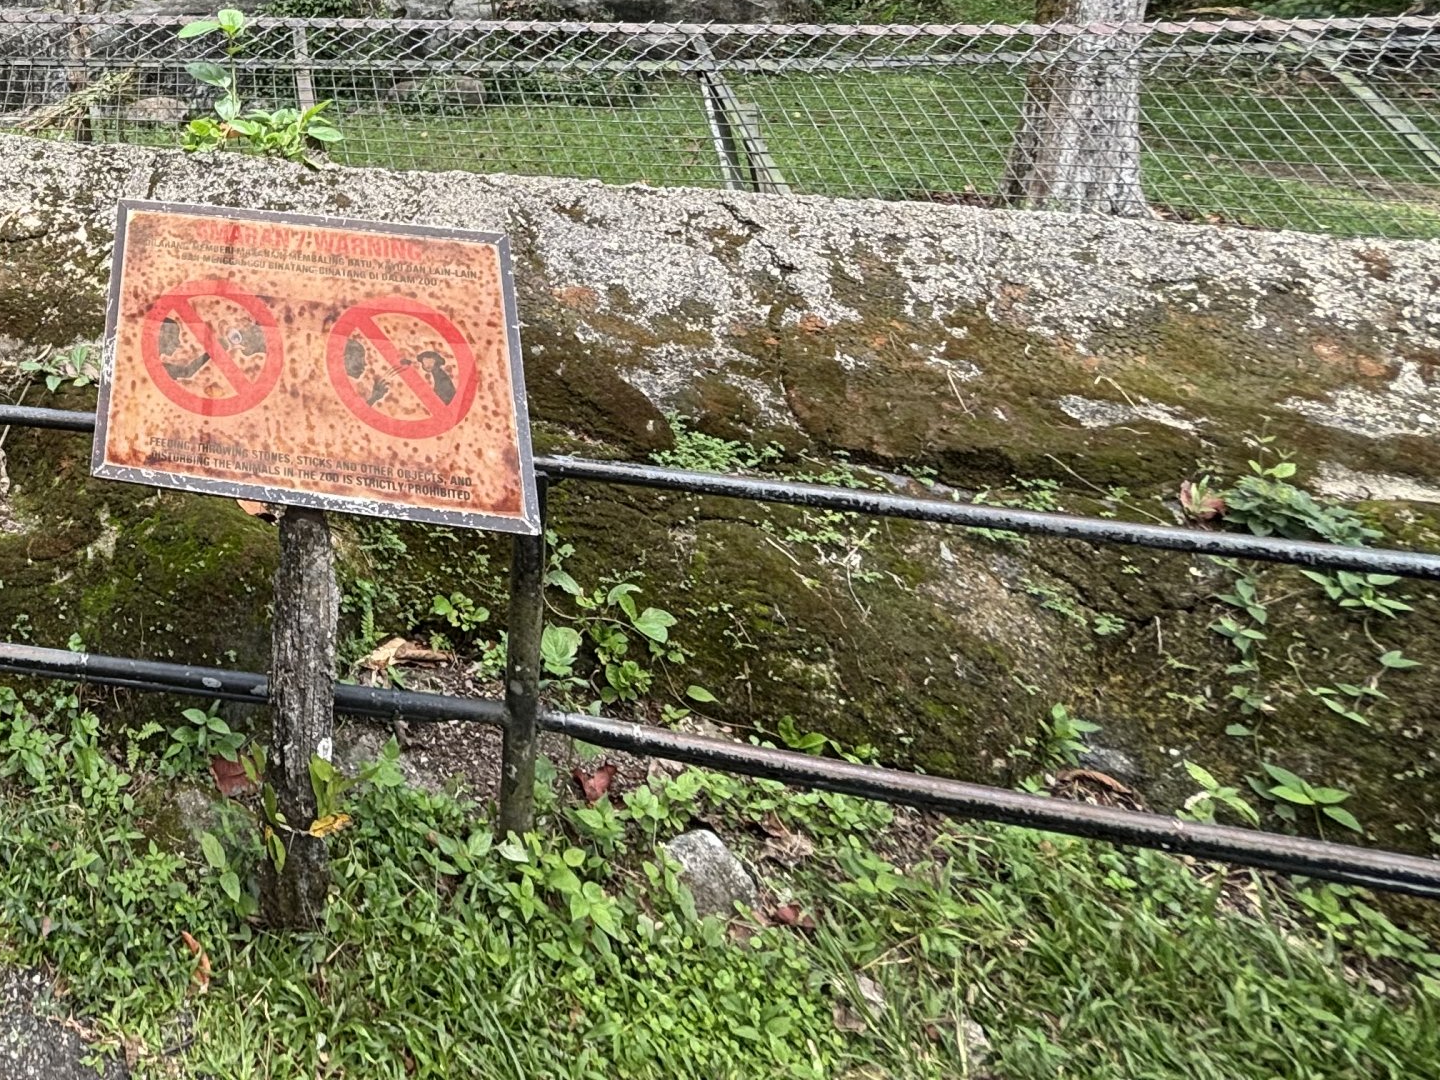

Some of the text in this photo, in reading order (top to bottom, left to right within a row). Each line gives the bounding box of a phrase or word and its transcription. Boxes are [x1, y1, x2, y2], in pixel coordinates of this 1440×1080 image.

[313, 231, 423, 261] WARNING
[369, 271, 379, 281] DI
[381, 273, 415, 284] DALAM
[418, 276, 438, 287] ZOO
[151, 450, 471, 501] DISTURBING THE ANIMALS IN THE ZOO IS STRICTLY PROHIBITED
[198, 442, 250, 458] THROWING
[252, 449, 293, 465] STONES,
[296, 456, 332, 469] STICKS
[335, 461, 357, 471] AND
[360, 463, 393, 477] OTHER
[397, 468, 447, 485] OBJECTS,
[450, 476, 472, 487] AND
